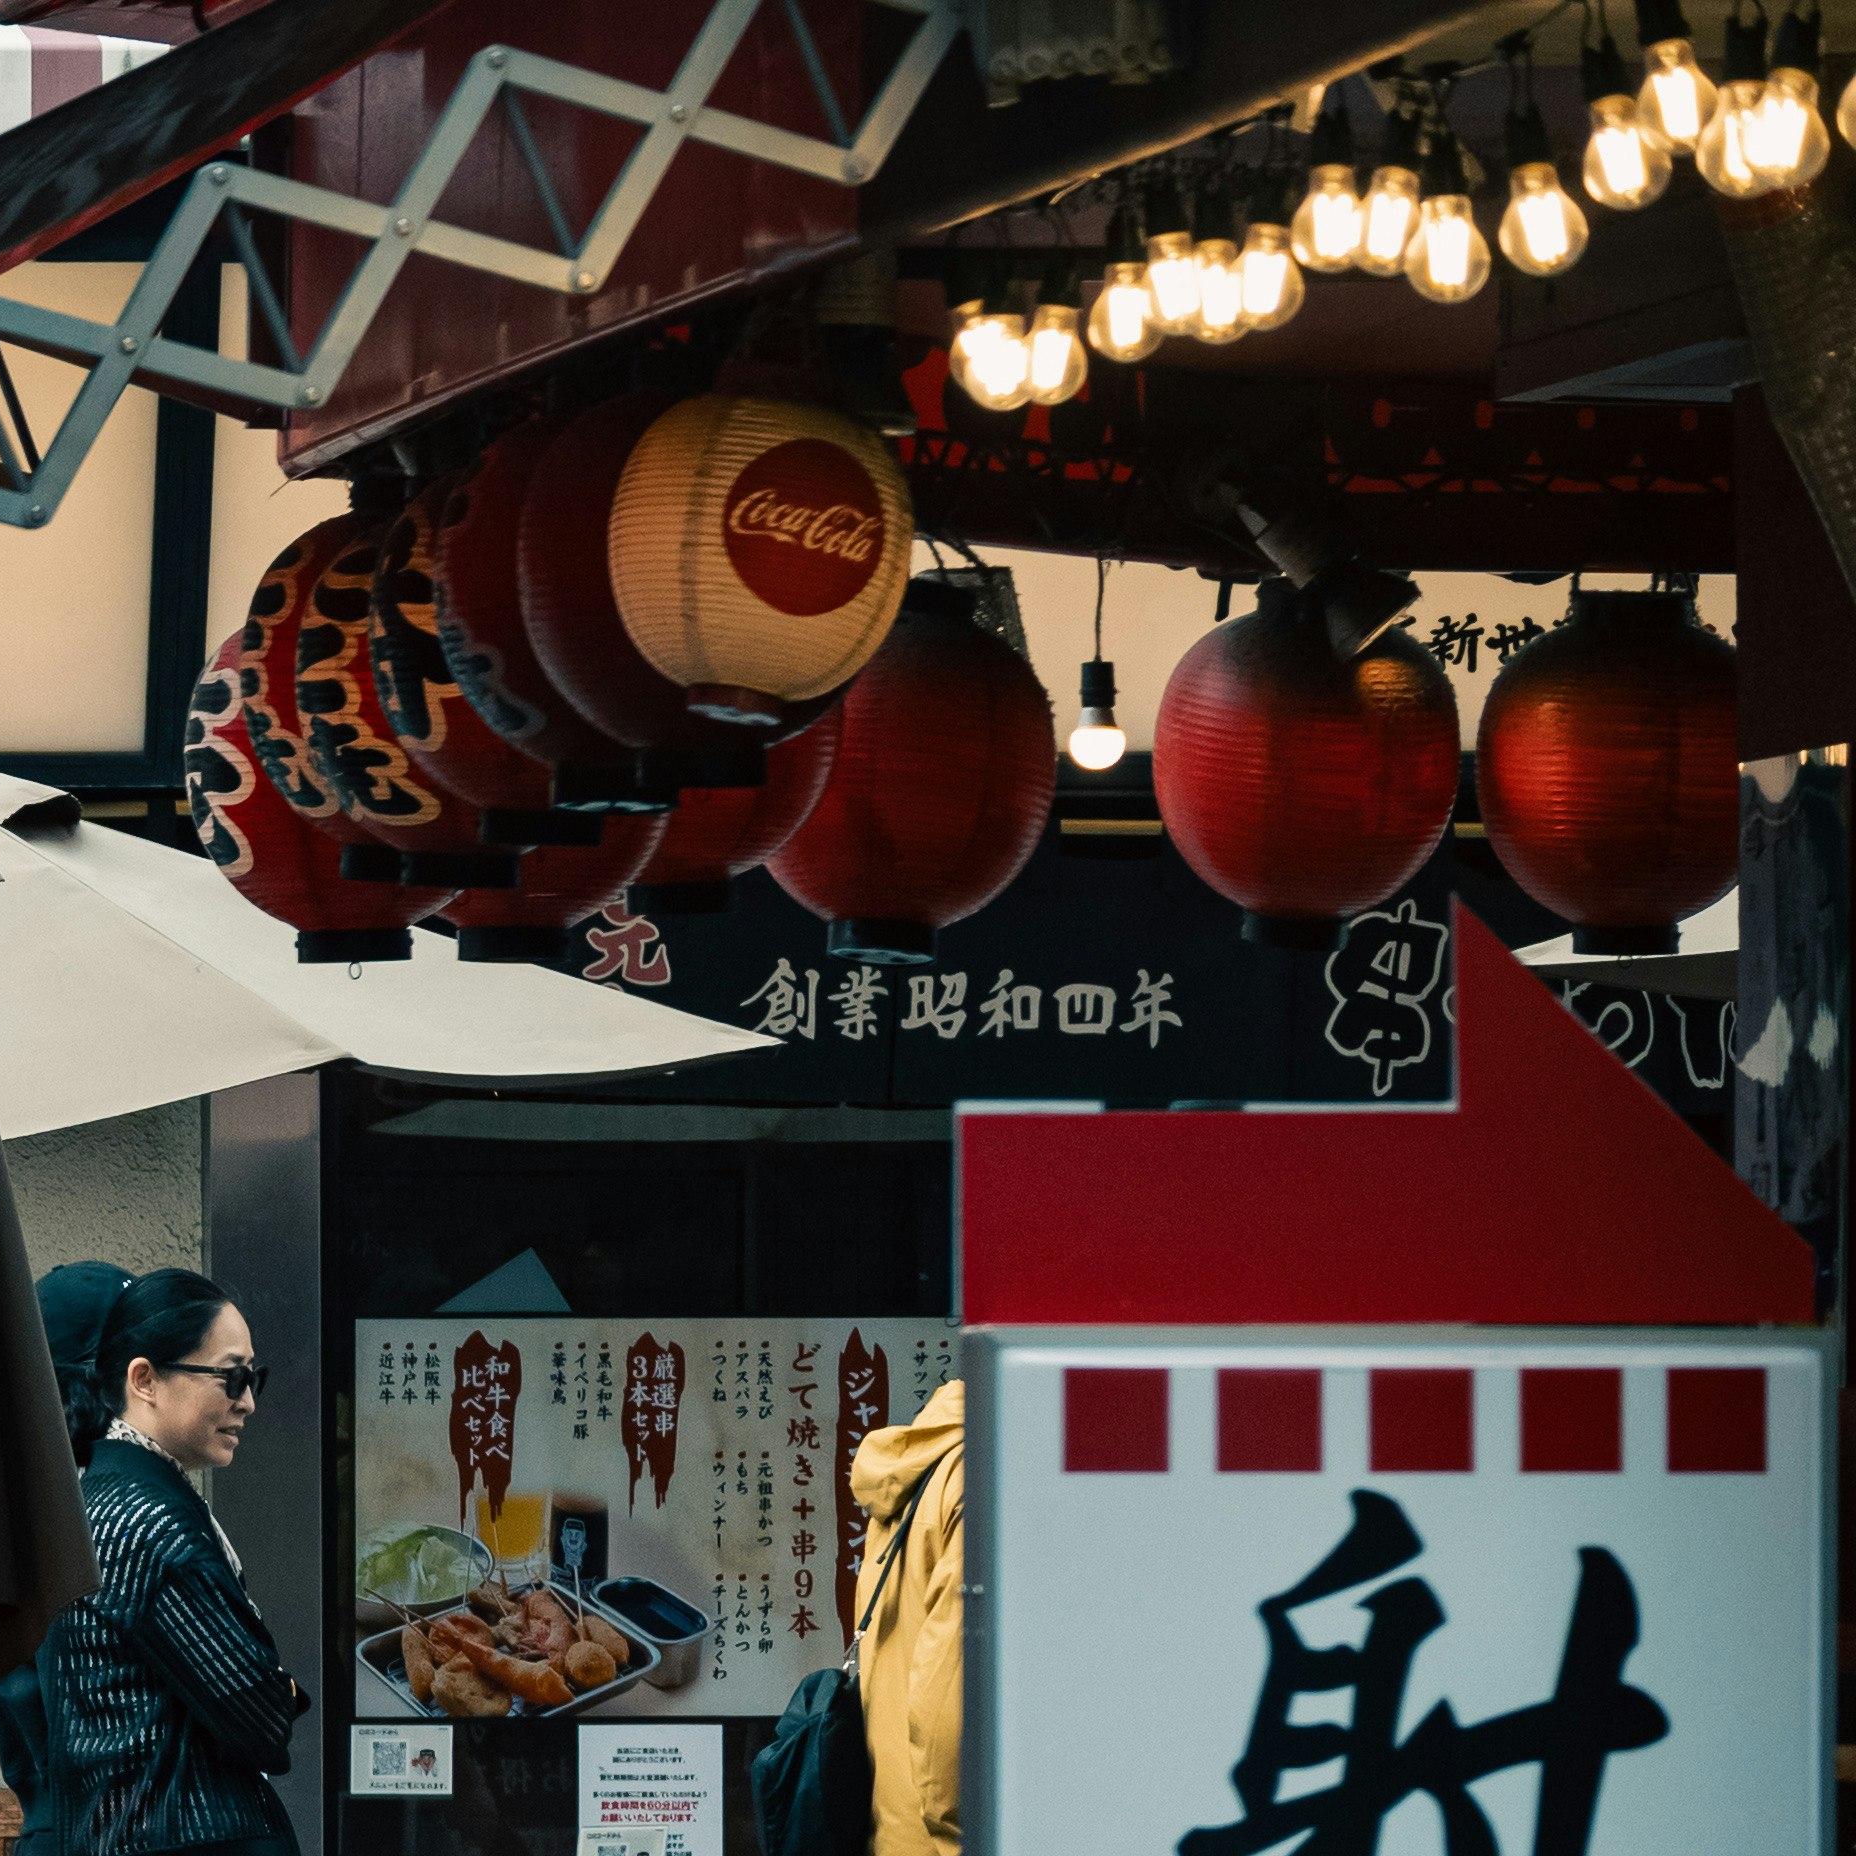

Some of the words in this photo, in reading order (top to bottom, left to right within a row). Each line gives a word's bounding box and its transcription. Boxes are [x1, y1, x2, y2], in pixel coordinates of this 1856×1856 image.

[728, 488, 883, 563] Coca-Cola
[740, 958, 1184, 1048] 創業昭和四年
[378, 1352, 395, 1406] 近江牛
[401, 1352, 419, 1405] 神戸牛
[424, 1352, 441, 1405] 松阪牛
[484, 1354, 511, 1462] 和牛食べ
[573, 1352, 590, 1440] イベリコ豚
[596, 1352, 613, 1421] 黒毛和牛
[630, 1355, 651, 1462] 3本セット
[651, 1353, 677, 1438] 厳選串
[711, 1353, 727, 1402] つくね
[735, 1352, 749, 1419] アスパラ
[757, 1351, 774, 1420] 天然えび
[461, 1364, 486, 1467] 比べセット
[736, 1462, 749, 1495] もち
[757, 1462, 774, 1547] 元祖串かつ
[711, 1584, 728, 1680] チーズちくわ
[735, 1584, 750, 1653] とんかつ
[758, 1583, 774, 1654] うずら卵
